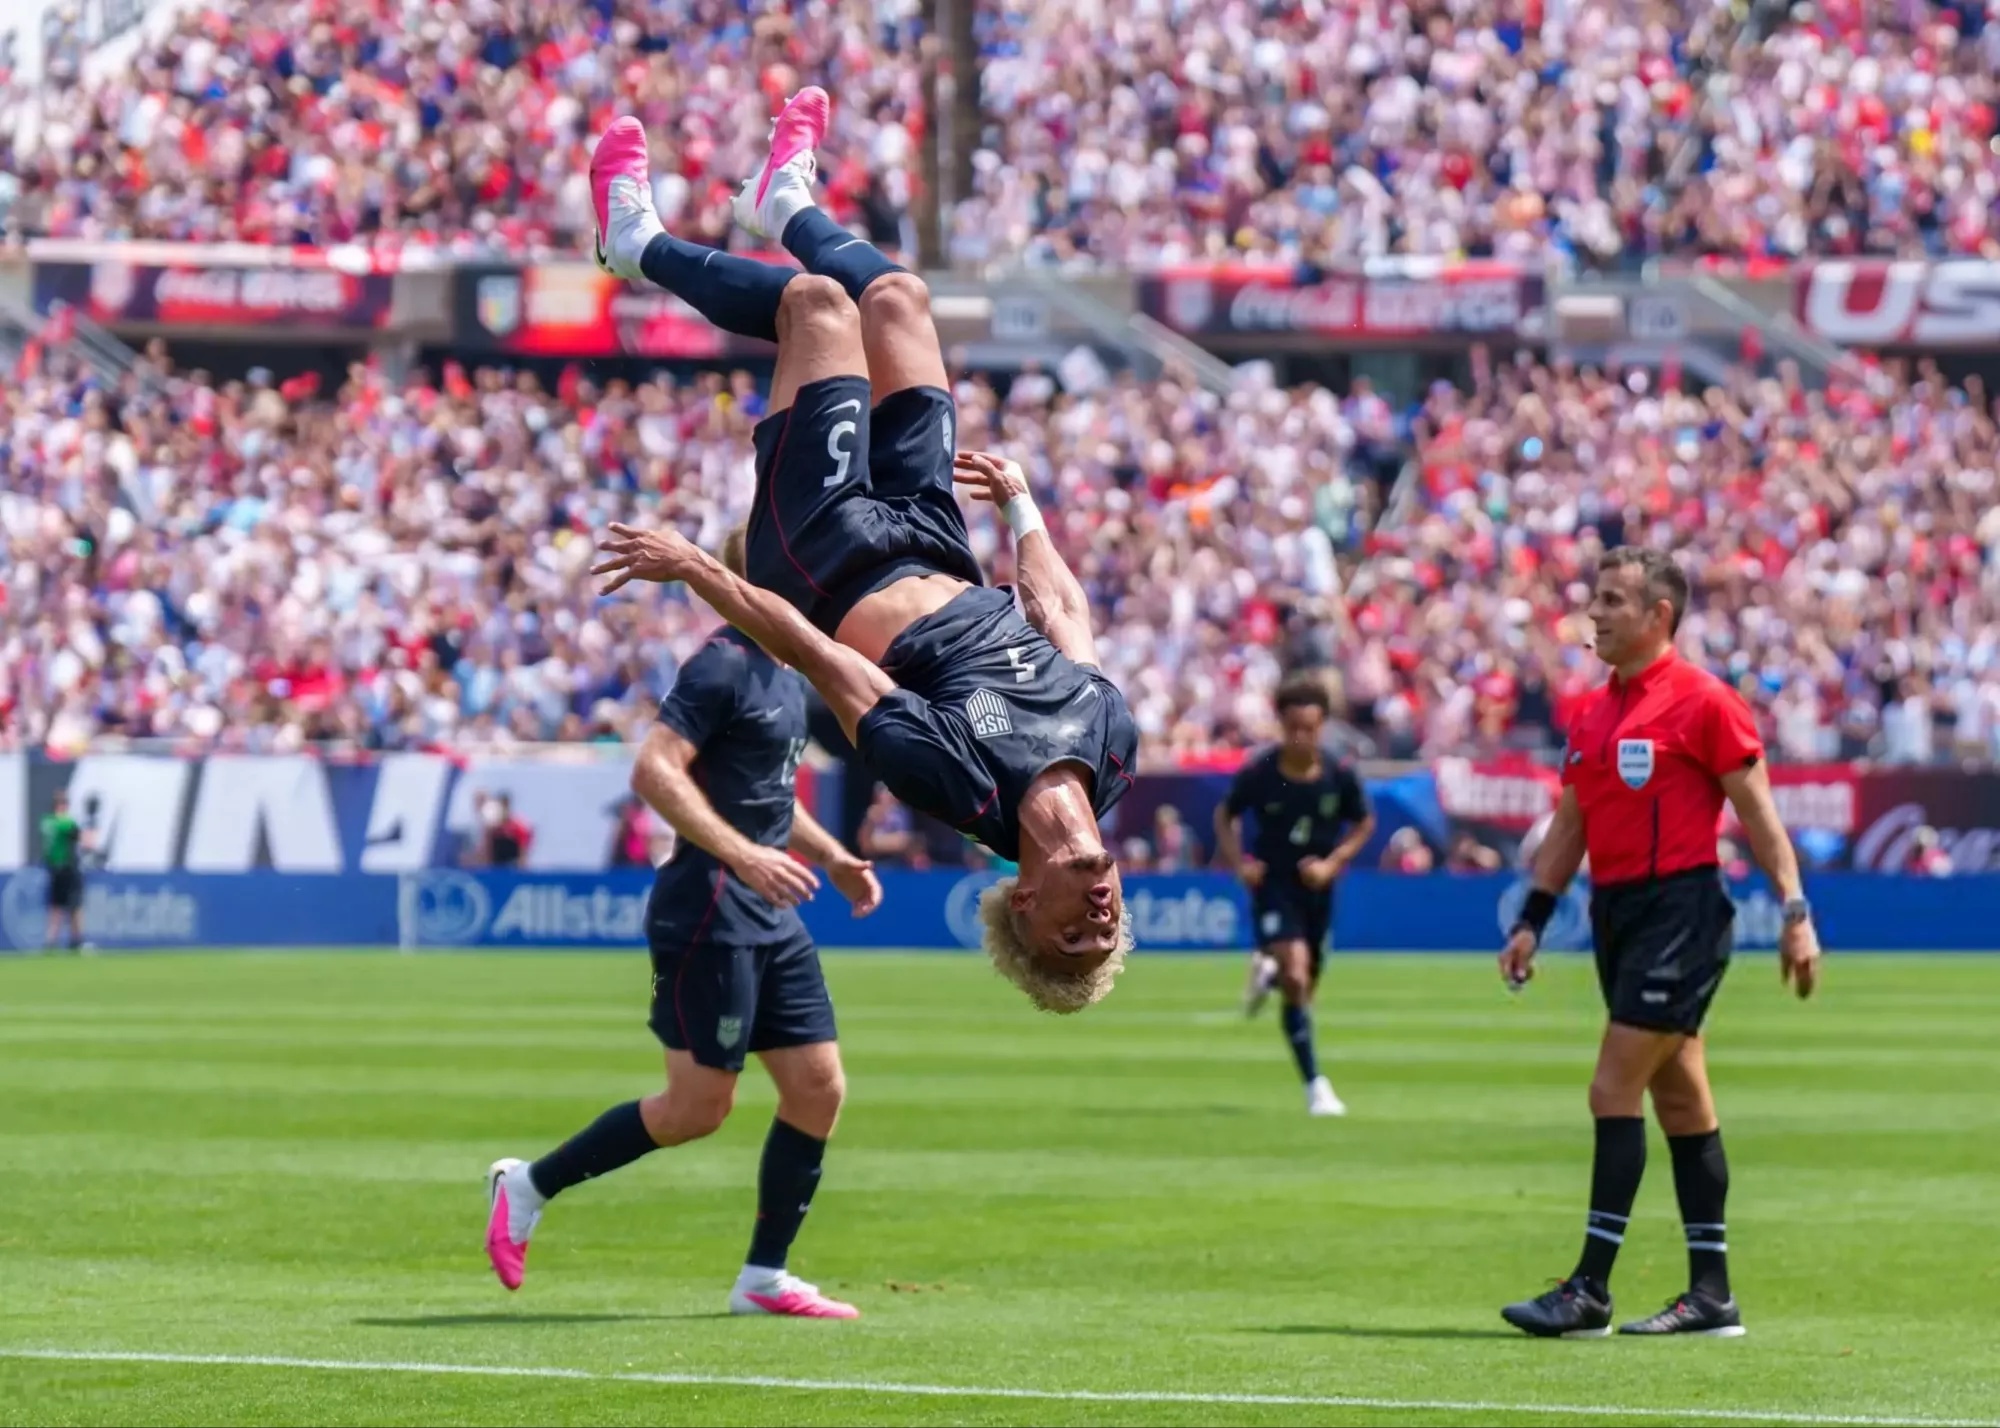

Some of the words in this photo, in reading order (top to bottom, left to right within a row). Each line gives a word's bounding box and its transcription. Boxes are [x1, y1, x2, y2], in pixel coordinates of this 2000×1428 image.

[823, 420, 856, 488] 5
[975, 714, 1010, 736] USA
[1621, 743, 1649, 755] FIFA
[82, 883, 198, 937] llstate
[490, 883, 653, 940] Allsta
[1124, 887, 1237, 943] tate
